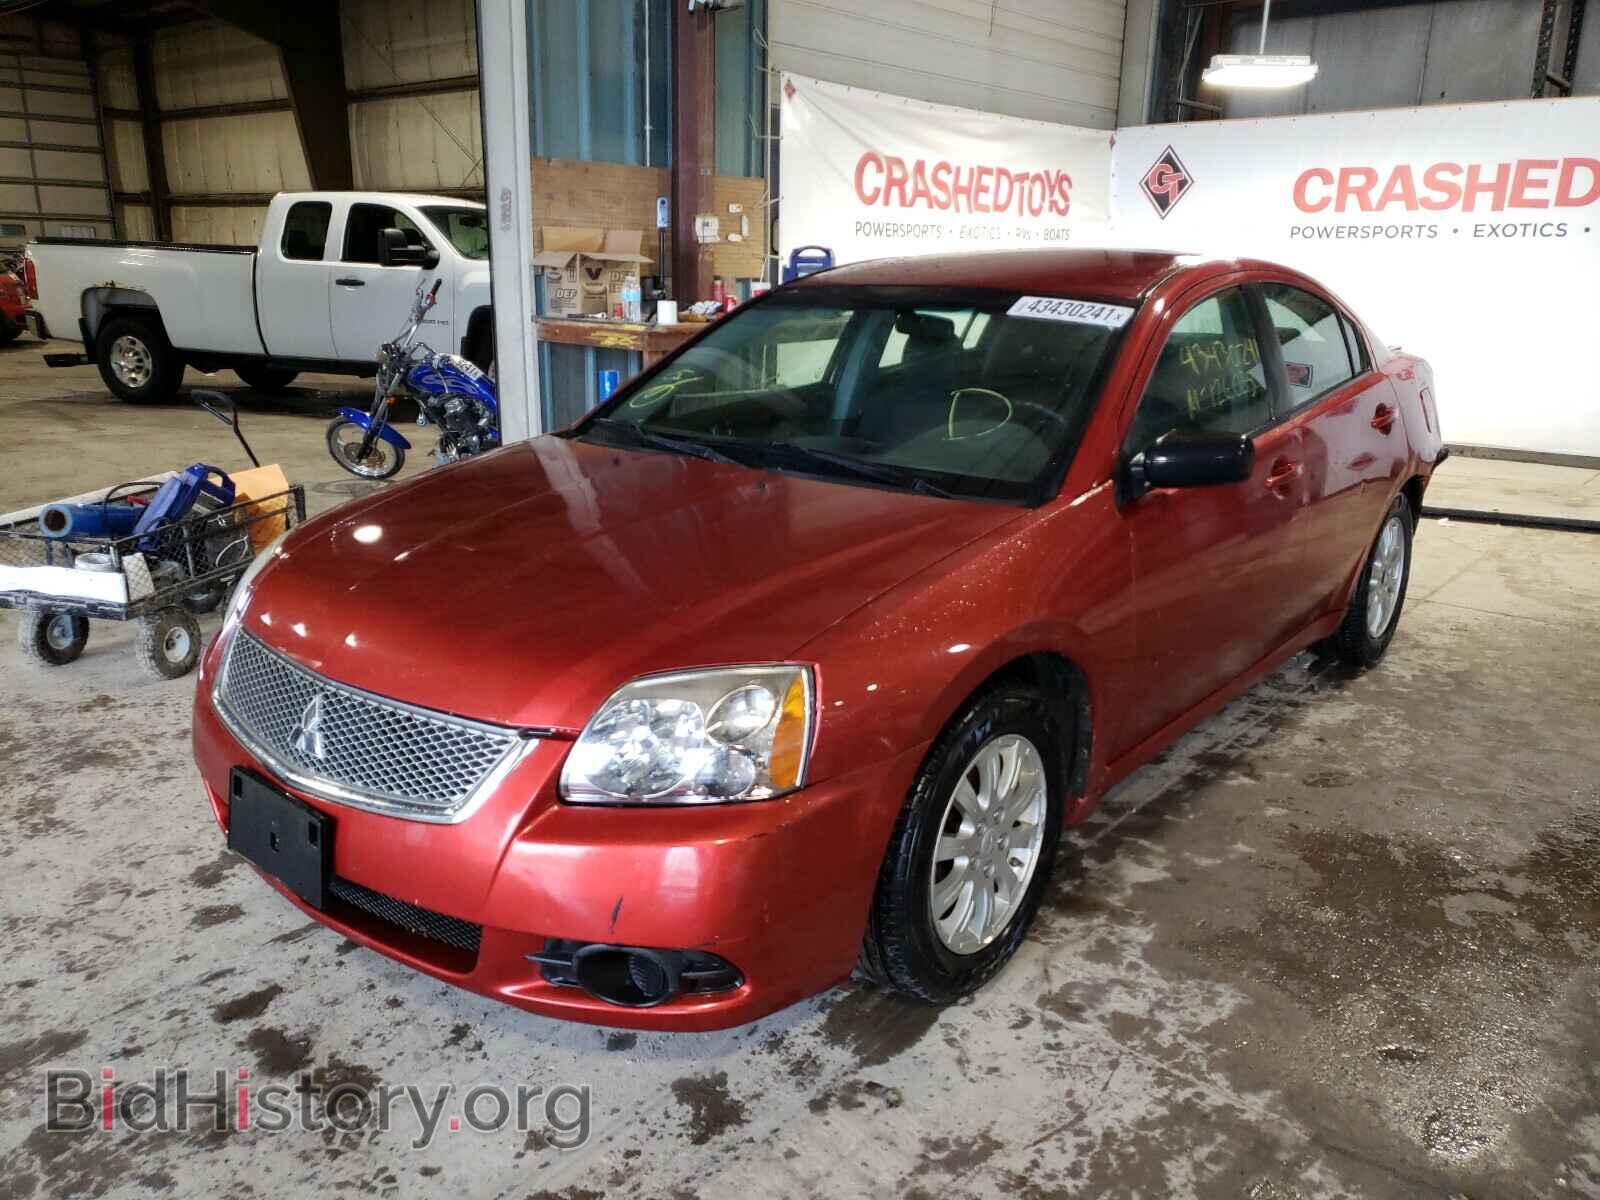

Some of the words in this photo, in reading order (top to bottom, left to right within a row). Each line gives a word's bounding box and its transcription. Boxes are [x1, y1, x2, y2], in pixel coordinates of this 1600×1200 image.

[854, 151, 1073, 217] CRASHEDTOYS
[1293, 157, 1600, 213] CRASHED
[855, 220, 943, 239] POWERSPORTS
[1043, 227, 1070, 241] BOATS
[1290, 225, 1438, 240] POWERSPORTS
[1472, 222, 1568, 238] EXOTICS
